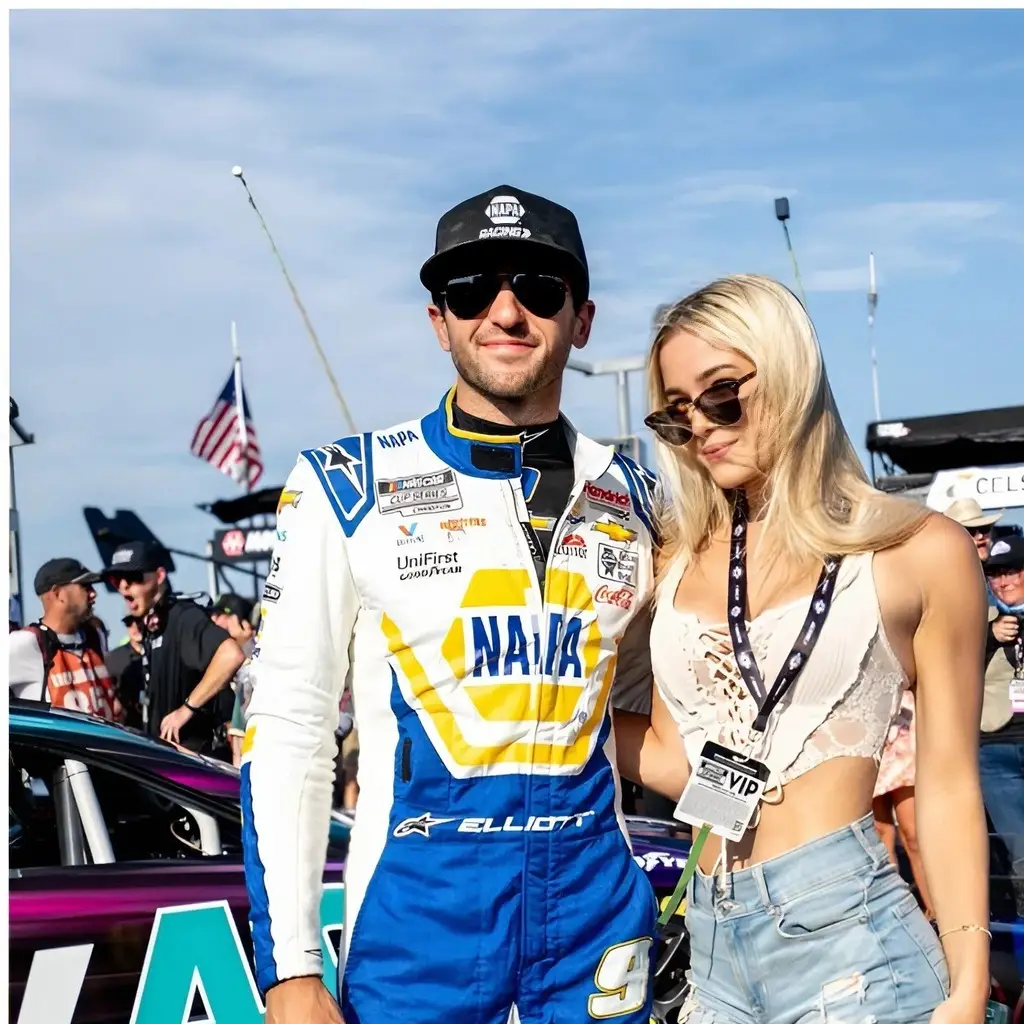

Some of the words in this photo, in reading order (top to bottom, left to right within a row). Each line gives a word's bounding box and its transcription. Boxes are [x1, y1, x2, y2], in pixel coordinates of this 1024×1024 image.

[490, 203, 519, 217] NAPA
[479, 226, 522, 239] RACING
[376, 429, 419, 449] NAPA
[397, 552, 458, 570] UniFirst
[471, 612, 582, 678] NAPA
[730, 771, 759, 797] VIP
[587, 936, 653, 1019] 9
